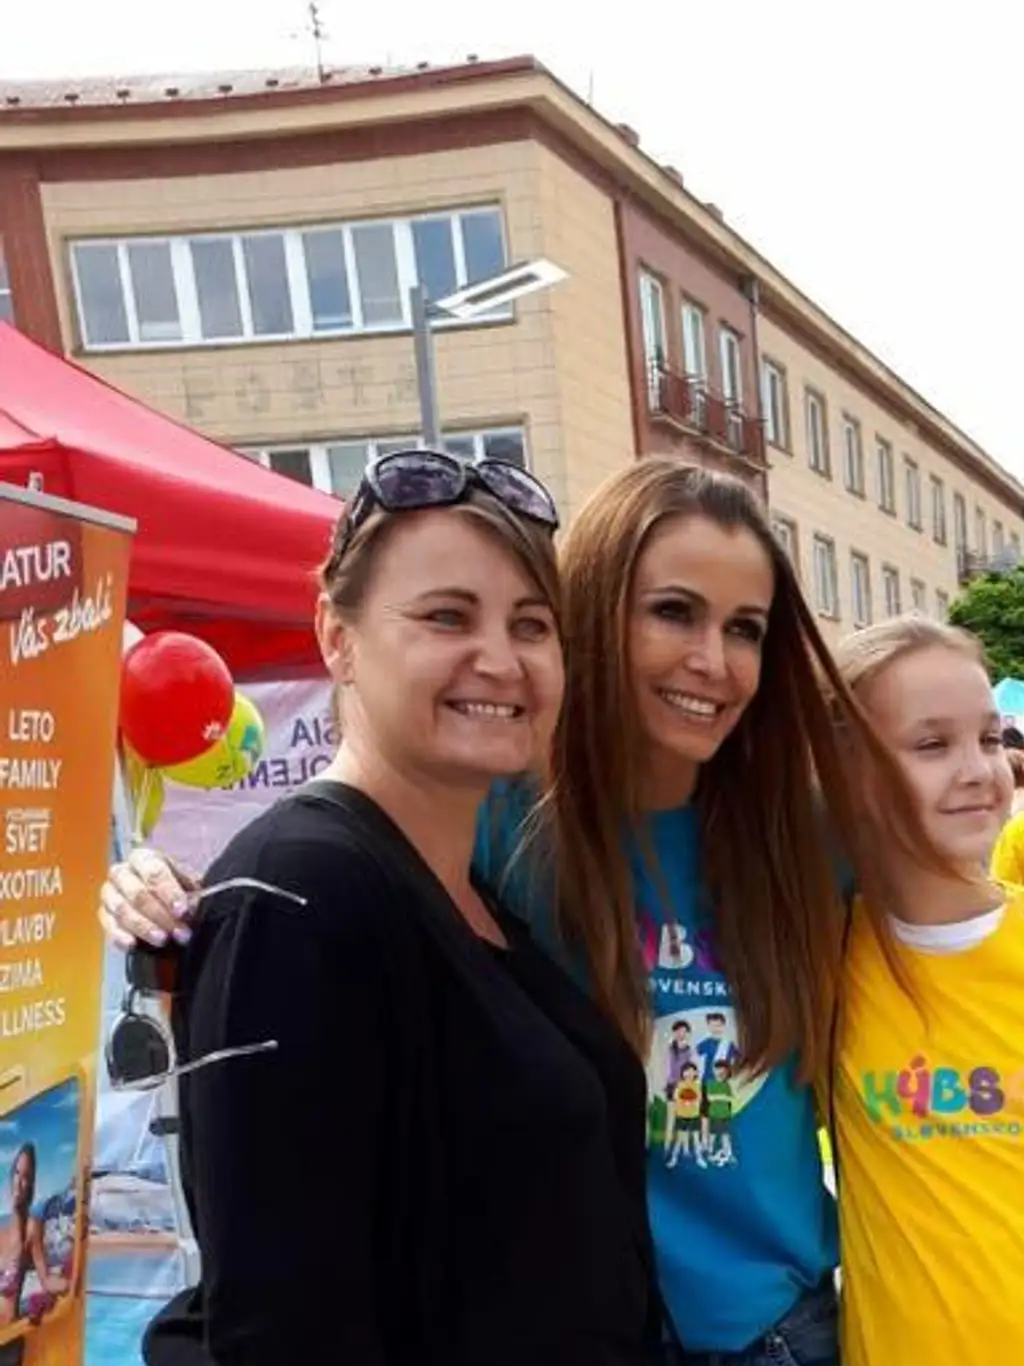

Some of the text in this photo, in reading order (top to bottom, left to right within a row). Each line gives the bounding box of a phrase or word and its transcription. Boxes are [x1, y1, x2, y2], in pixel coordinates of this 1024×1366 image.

[9, 708, 55, 742] LETO
[0, 757, 62, 790] FAMILY
[5, 821, 51, 853] SVET
[0, 865, 63, 900] XOTIKA
[2, 911, 56, 947] LAVBY
[2, 997, 66, 1037] LLNESS
